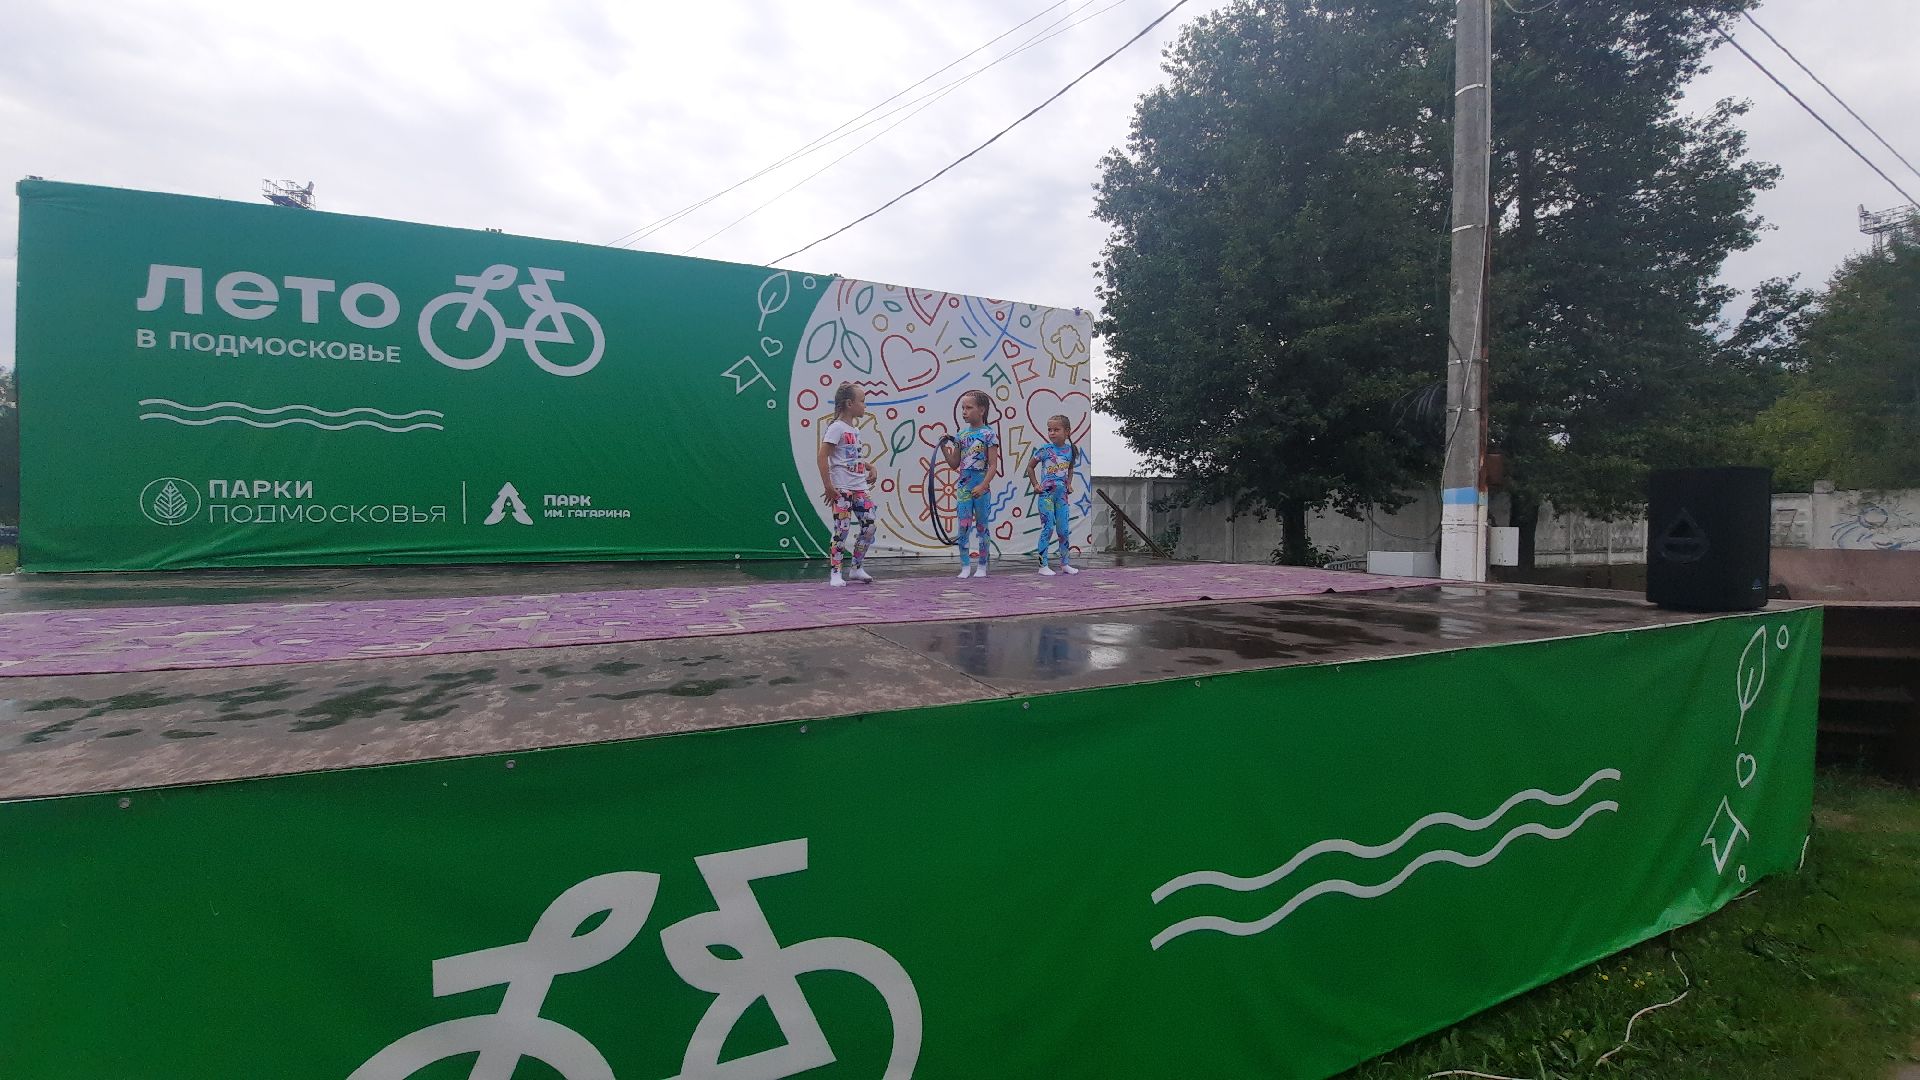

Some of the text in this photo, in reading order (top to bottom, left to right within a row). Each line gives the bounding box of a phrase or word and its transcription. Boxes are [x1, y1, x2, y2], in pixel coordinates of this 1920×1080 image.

[136, 329, 401, 363] В ПОДМОСКОВЬЕ
[208, 479, 313, 499] ПАРКИ
[543, 494, 592, 507] ПАРК
[209, 504, 446, 524] ПОДМОСКОВЬЯ
[544, 509, 631, 519] ИМ. ГАГАРИНА
